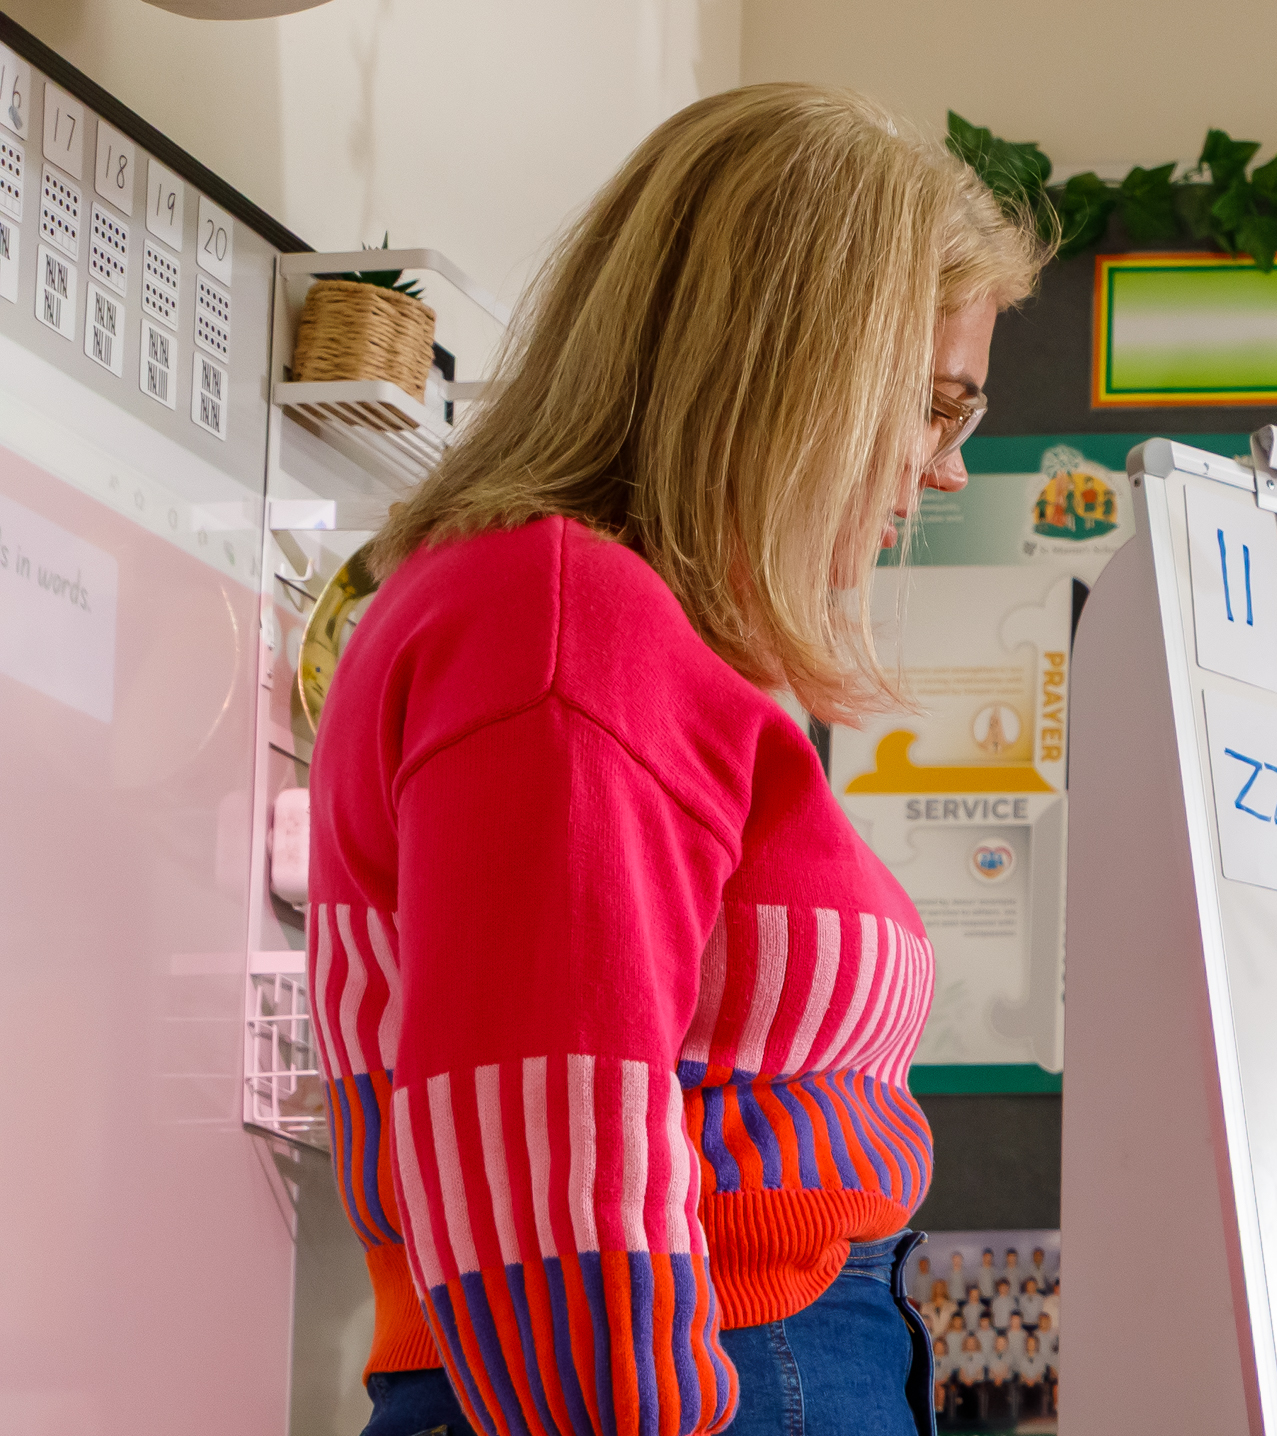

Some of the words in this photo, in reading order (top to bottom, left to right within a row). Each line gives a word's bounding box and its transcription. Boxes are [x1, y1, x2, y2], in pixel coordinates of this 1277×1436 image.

[0, 65, 22, 109] 16
[53, 107, 76, 151] 17
[105, 145, 128, 189] 18
[156, 183, 177, 226] 19
[203, 218, 228, 263] 20
[16, 545, 31, 579] in
[1041, 650, 1066, 763] PRAYER
[905, 798, 1029, 820] SERVICE
